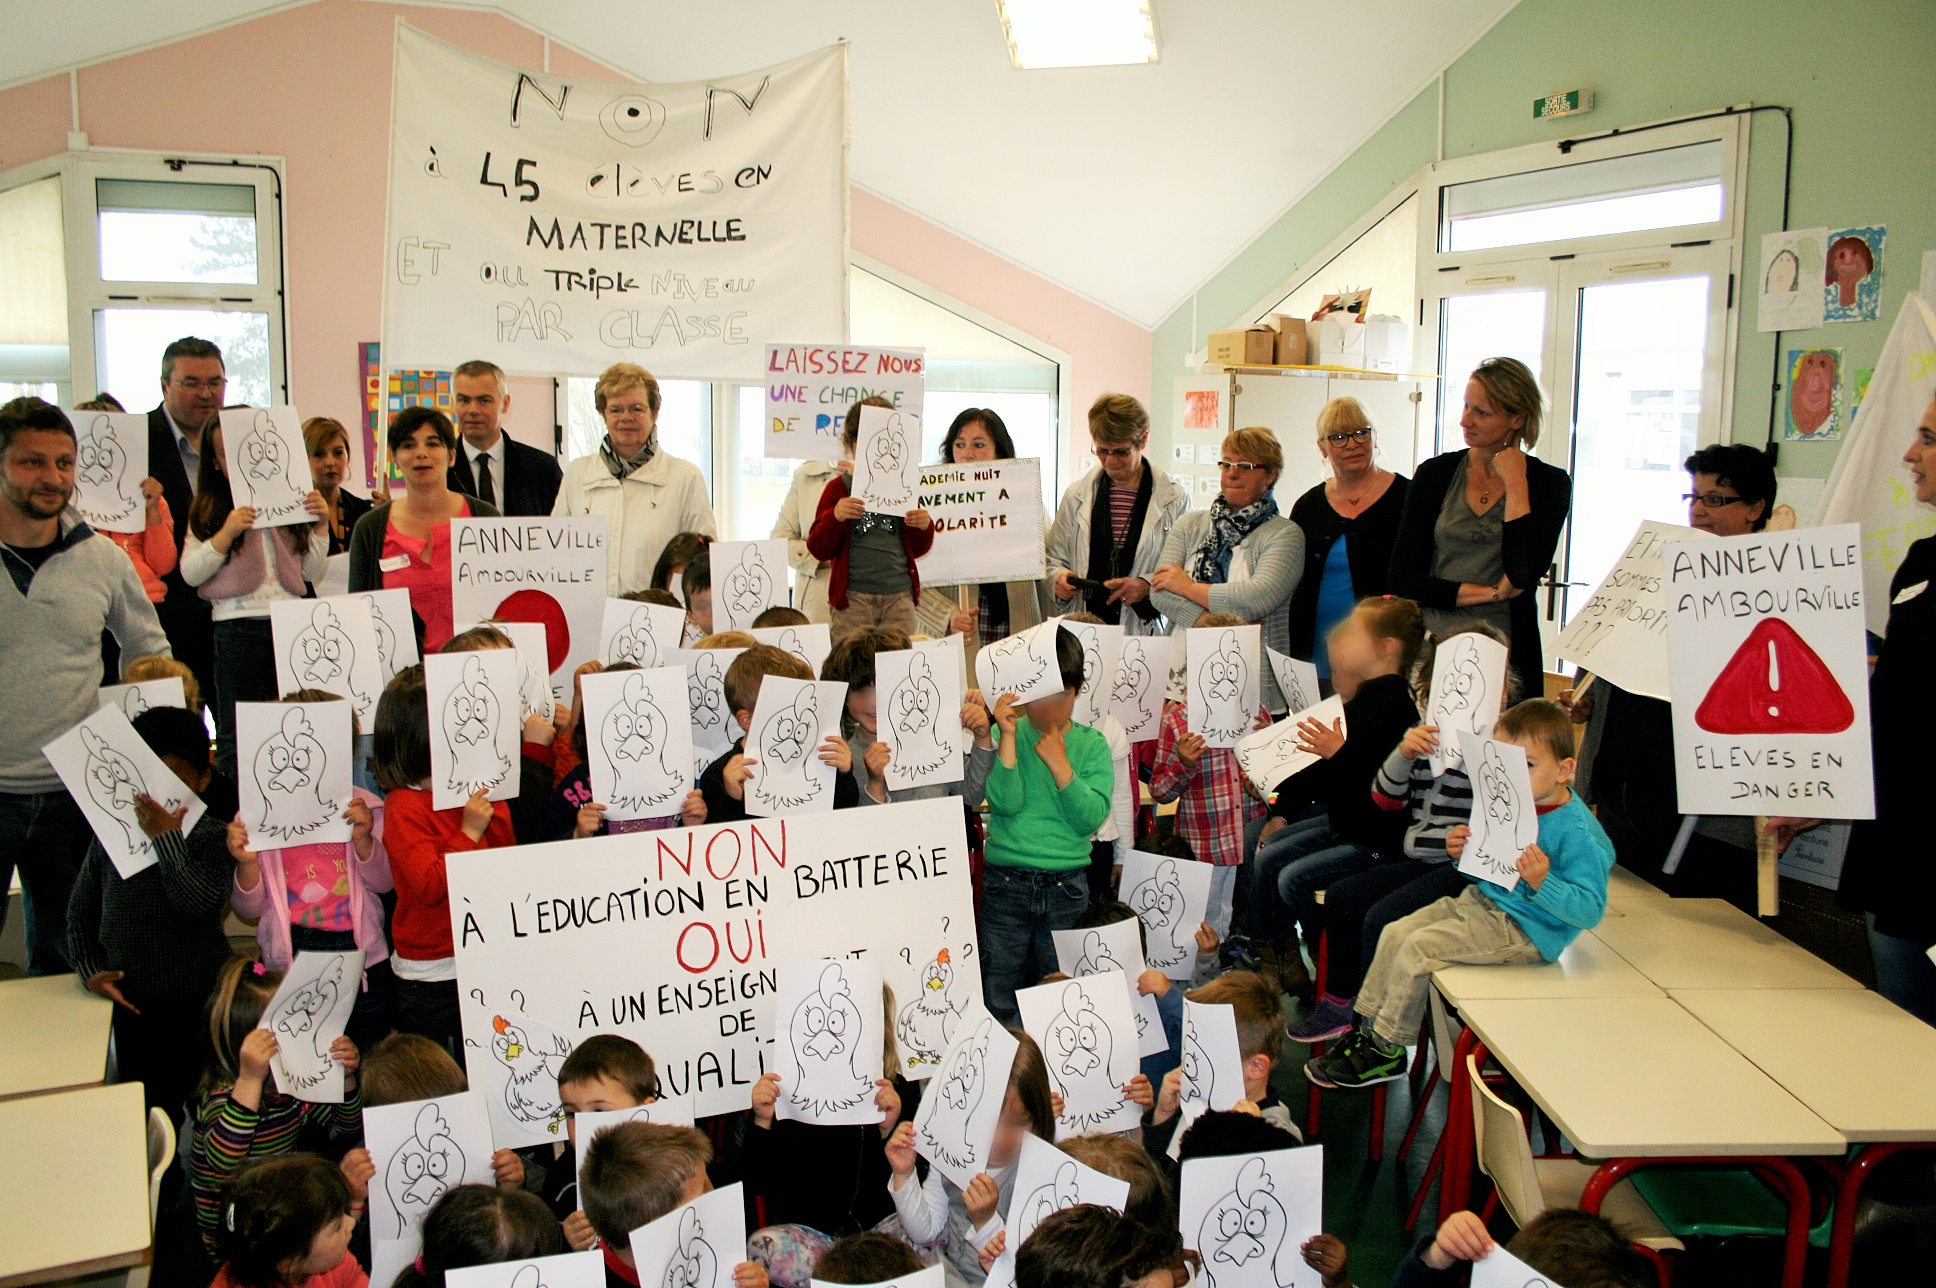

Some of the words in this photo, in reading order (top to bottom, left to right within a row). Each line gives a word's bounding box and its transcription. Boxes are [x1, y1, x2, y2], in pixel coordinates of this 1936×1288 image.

[510, 73, 770, 147] NON
[1541, 101, 1570, 116] SECOURS
[1545, 94, 1567, 107] SORTIE
[480, 152, 540, 202] 45
[526, 216, 747, 250] MATERNELLE
[397, 236, 450, 285] ET
[496, 298, 573, 342] PAR
[599, 306, 749, 348] CLASSE
[769, 347, 869, 374] LAISSEZ
[877, 354, 922, 375] NOUS
[770, 384, 809, 403] UNE
[773, 417, 800, 433] DE
[919, 471, 966, 487] ADEMIE
[975, 469, 1001, 481] NUIT
[918, 491, 986, 509] AVEMENT
[999, 488, 1010, 500] A
[934, 511, 1008, 534] OLARITE
[1605, 569, 1661, 593] SOMMES
[1582, 596, 1612, 617] PAS
[1611, 598, 1668, 636] PRIORI
[1694, 745, 1796, 770] ELEVES
[1811, 752, 1843, 769] EN
[1730, 781, 1835, 799] DANGER
[656, 820, 788, 882] NON
[306, 863, 317, 880] IS
[332, 858, 348, 873] YO
[725, 875, 769, 910] EN
[612, 989, 646, 1027] UN
[657, 967, 778, 1016] ENSEIGN
[719, 1008, 756, 1037] DE
[655, 1036, 776, 1100] UALI
